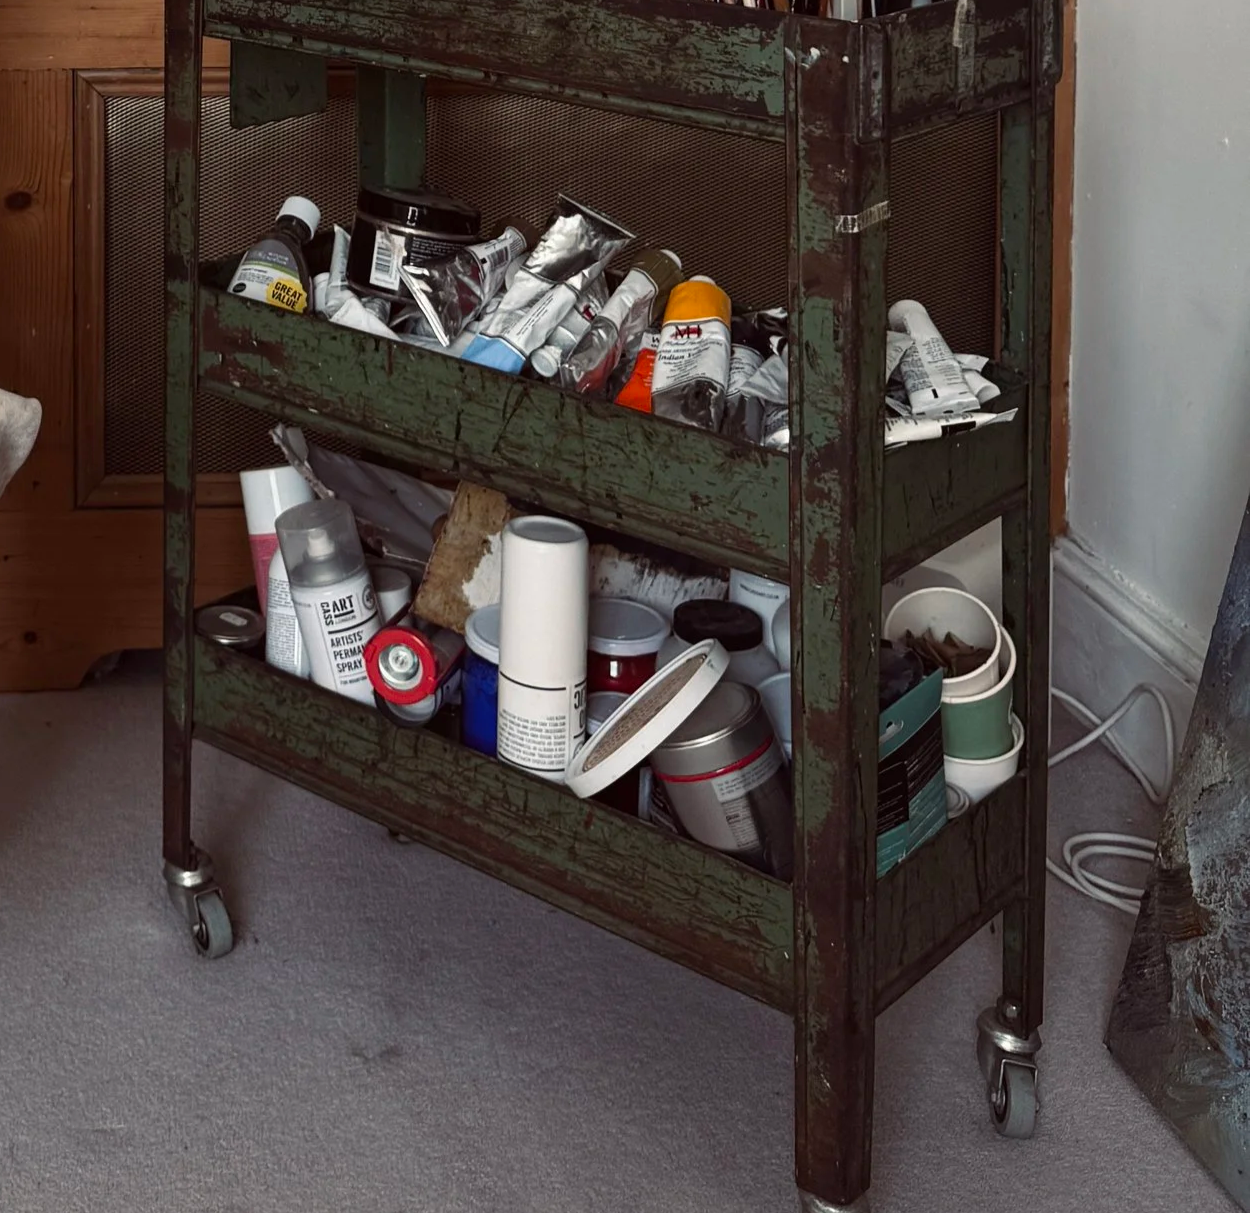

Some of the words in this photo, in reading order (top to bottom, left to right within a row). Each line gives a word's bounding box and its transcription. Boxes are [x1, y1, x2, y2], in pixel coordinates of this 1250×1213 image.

[272, 290, 298, 310] VALUE
[275, 282, 303, 301] GREAT
[332, 595, 354, 613] ART
[320, 601, 334, 626] CASS
[330, 630, 364, 647] ARTISTS'
[336, 659, 362, 673] SPRAY
